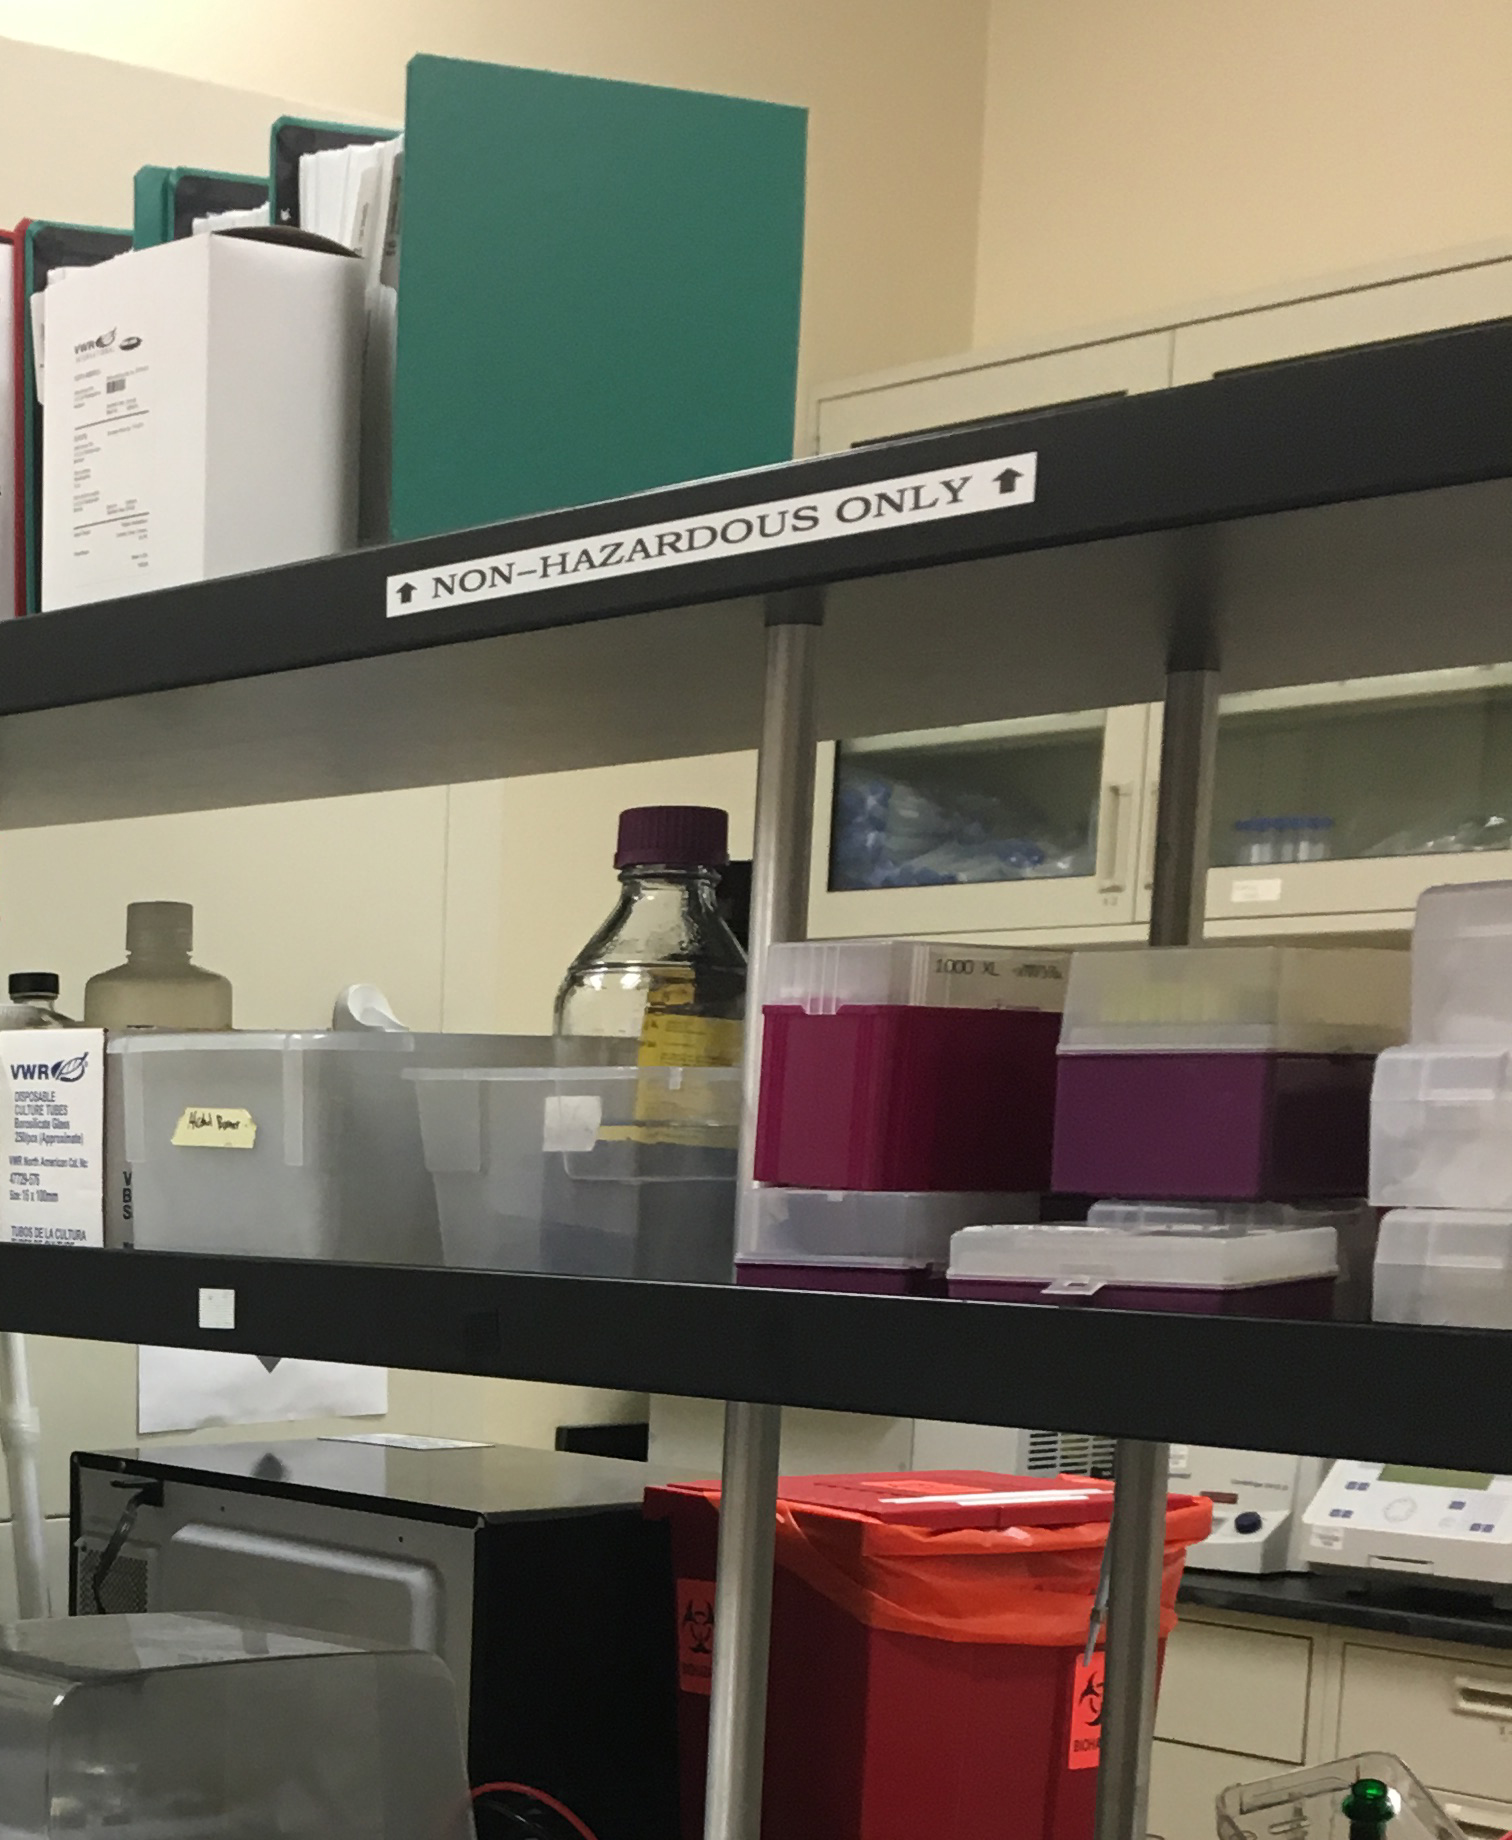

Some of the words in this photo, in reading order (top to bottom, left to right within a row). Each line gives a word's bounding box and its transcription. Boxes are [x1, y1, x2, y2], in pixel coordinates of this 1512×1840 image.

[432, 504, 820, 600] NON-HAZARDOUS
[835, 475, 975, 524] ONLY
[10, 1063, 50, 1080] VWR
[14, 1091, 56, 1103] DISPOSABLE
[14, 1103, 44, 1116] CULTURE
[46, 1104, 68, 1116] TUBES
[14, 1117, 50, 1129] Borosilicate
[9, 1155, 23, 1166] VWR
[23, 1157, 40, 1167] North
[40, 1157, 68, 1168] American
[11, 1226, 33, 1239] TUBOS
[34, 1227, 44, 1239] DE
[45, 1228, 54, 1240] LA
[55, 1228, 87, 1241] CULTURA
